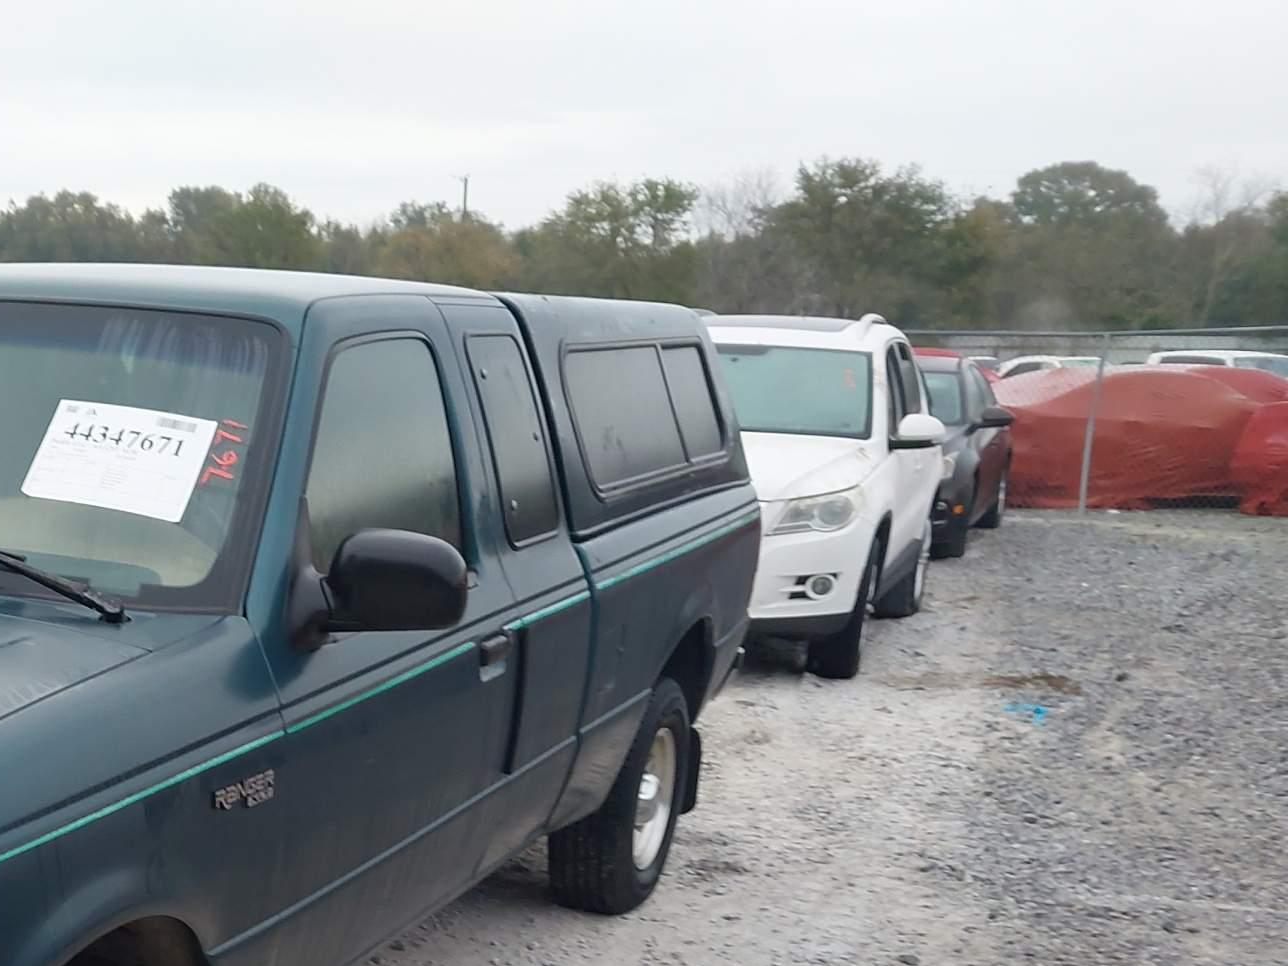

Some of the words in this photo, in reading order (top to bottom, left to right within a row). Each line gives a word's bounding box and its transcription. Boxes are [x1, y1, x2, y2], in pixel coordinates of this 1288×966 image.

[64, 422, 185, 457] 44347671
[199, 418, 249, 486] 7671
[214, 769, 274, 810] RANGER
